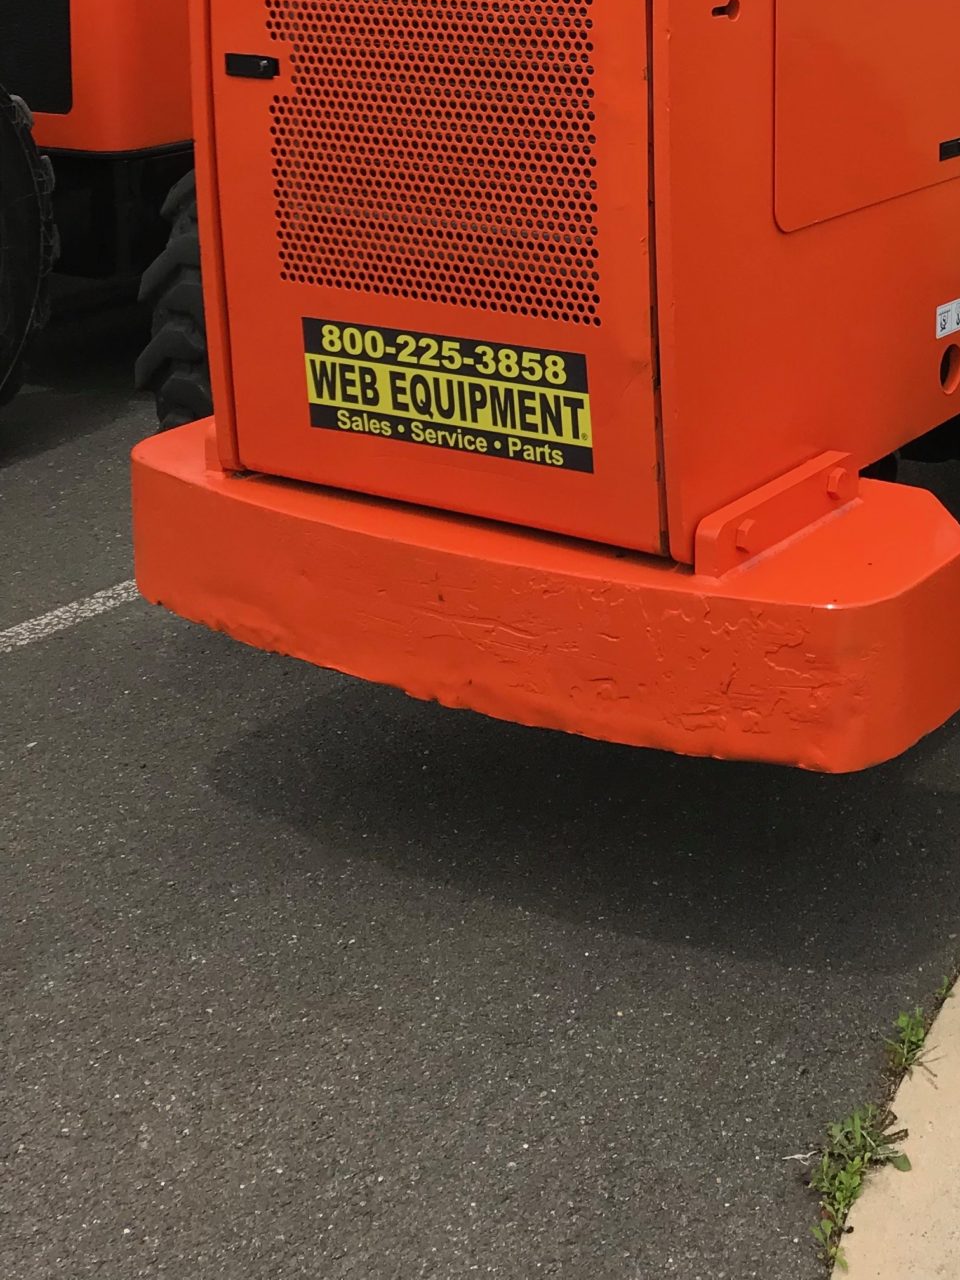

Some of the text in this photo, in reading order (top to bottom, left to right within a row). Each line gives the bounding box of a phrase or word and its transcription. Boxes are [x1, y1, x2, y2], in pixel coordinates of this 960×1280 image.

[321, 324, 567, 385] 800-225-3858
[309, 358, 585, 441] WEB EQUIPMENT
[336, 409, 564, 466] Sales Service Parts
